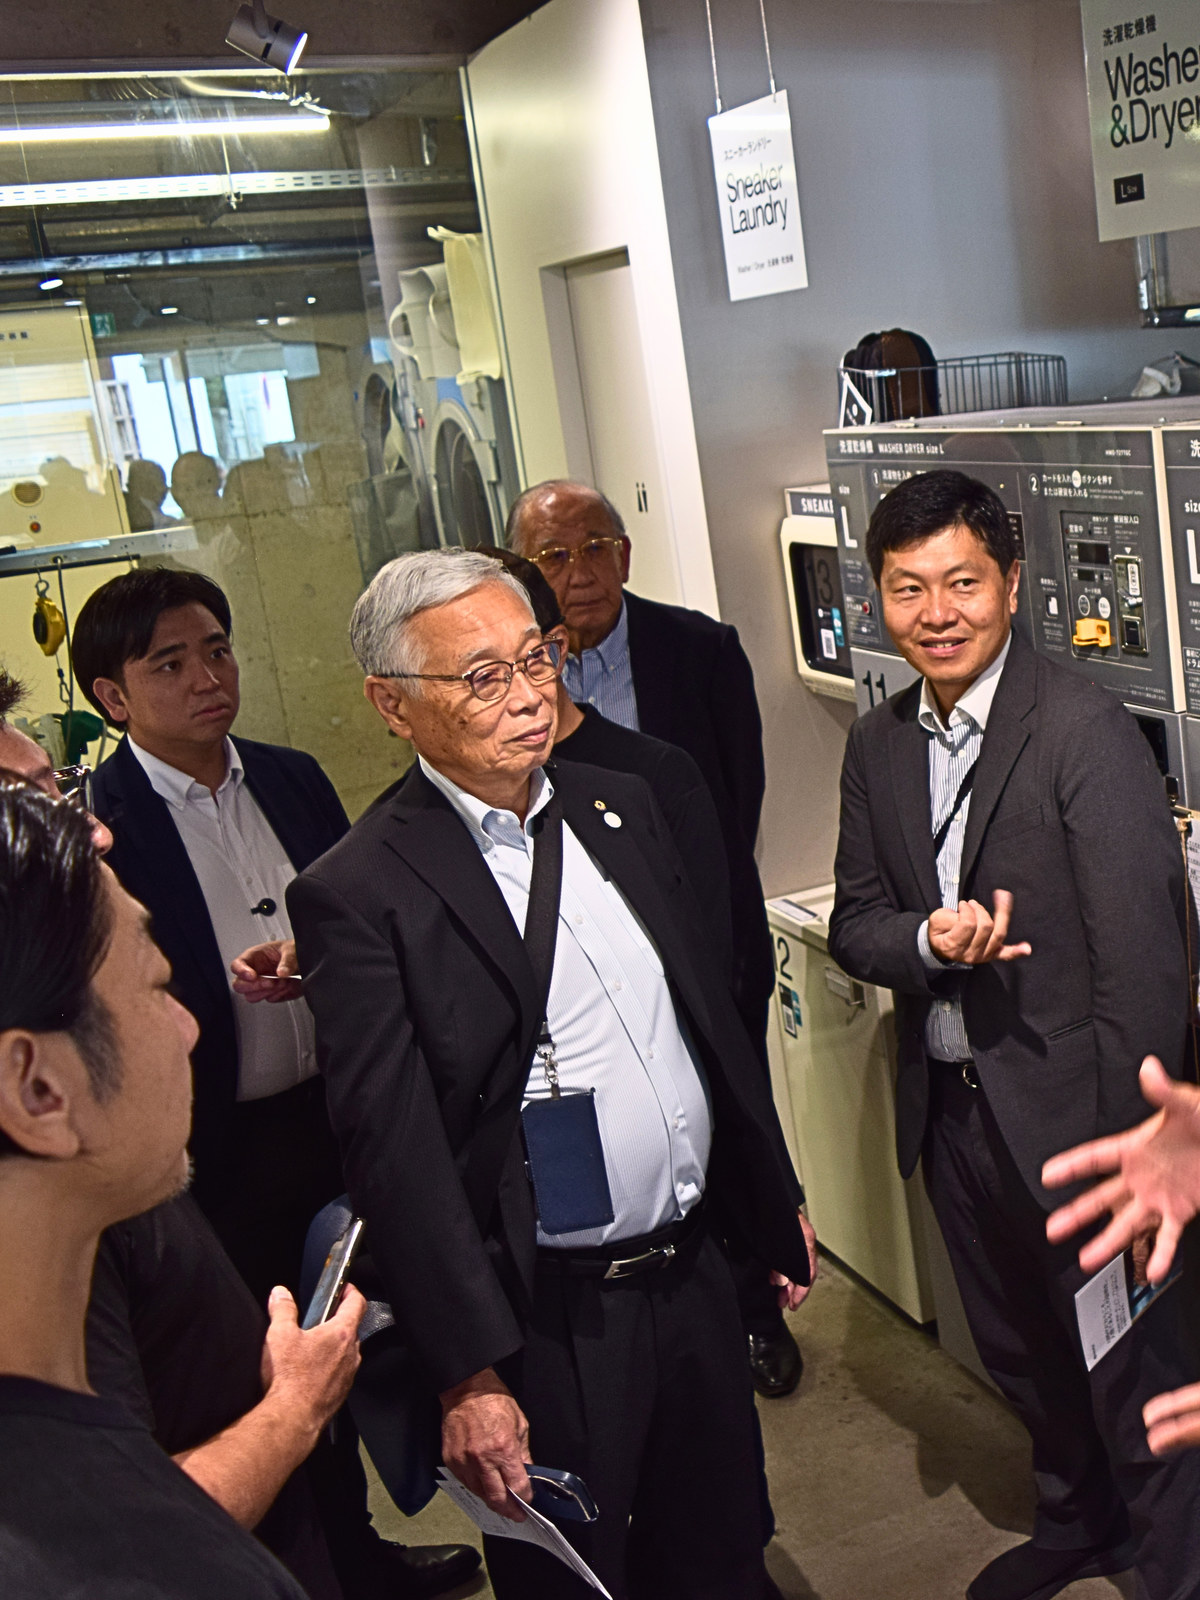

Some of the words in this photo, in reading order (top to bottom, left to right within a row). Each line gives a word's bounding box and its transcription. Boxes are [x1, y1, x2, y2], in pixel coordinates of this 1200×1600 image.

[1102, 14, 1156, 46] 洗濯乾燥機
[726, 162, 783, 203] Sneaker
[729, 193, 788, 235] Laundry
[878, 442, 904, 454] WASHER
[904, 442, 925, 454] DRYER
[926, 443, 938, 454] size
[839, 484, 850, 494] size
[841, 506, 858, 548] L
[862, 670, 886, 708] 11
